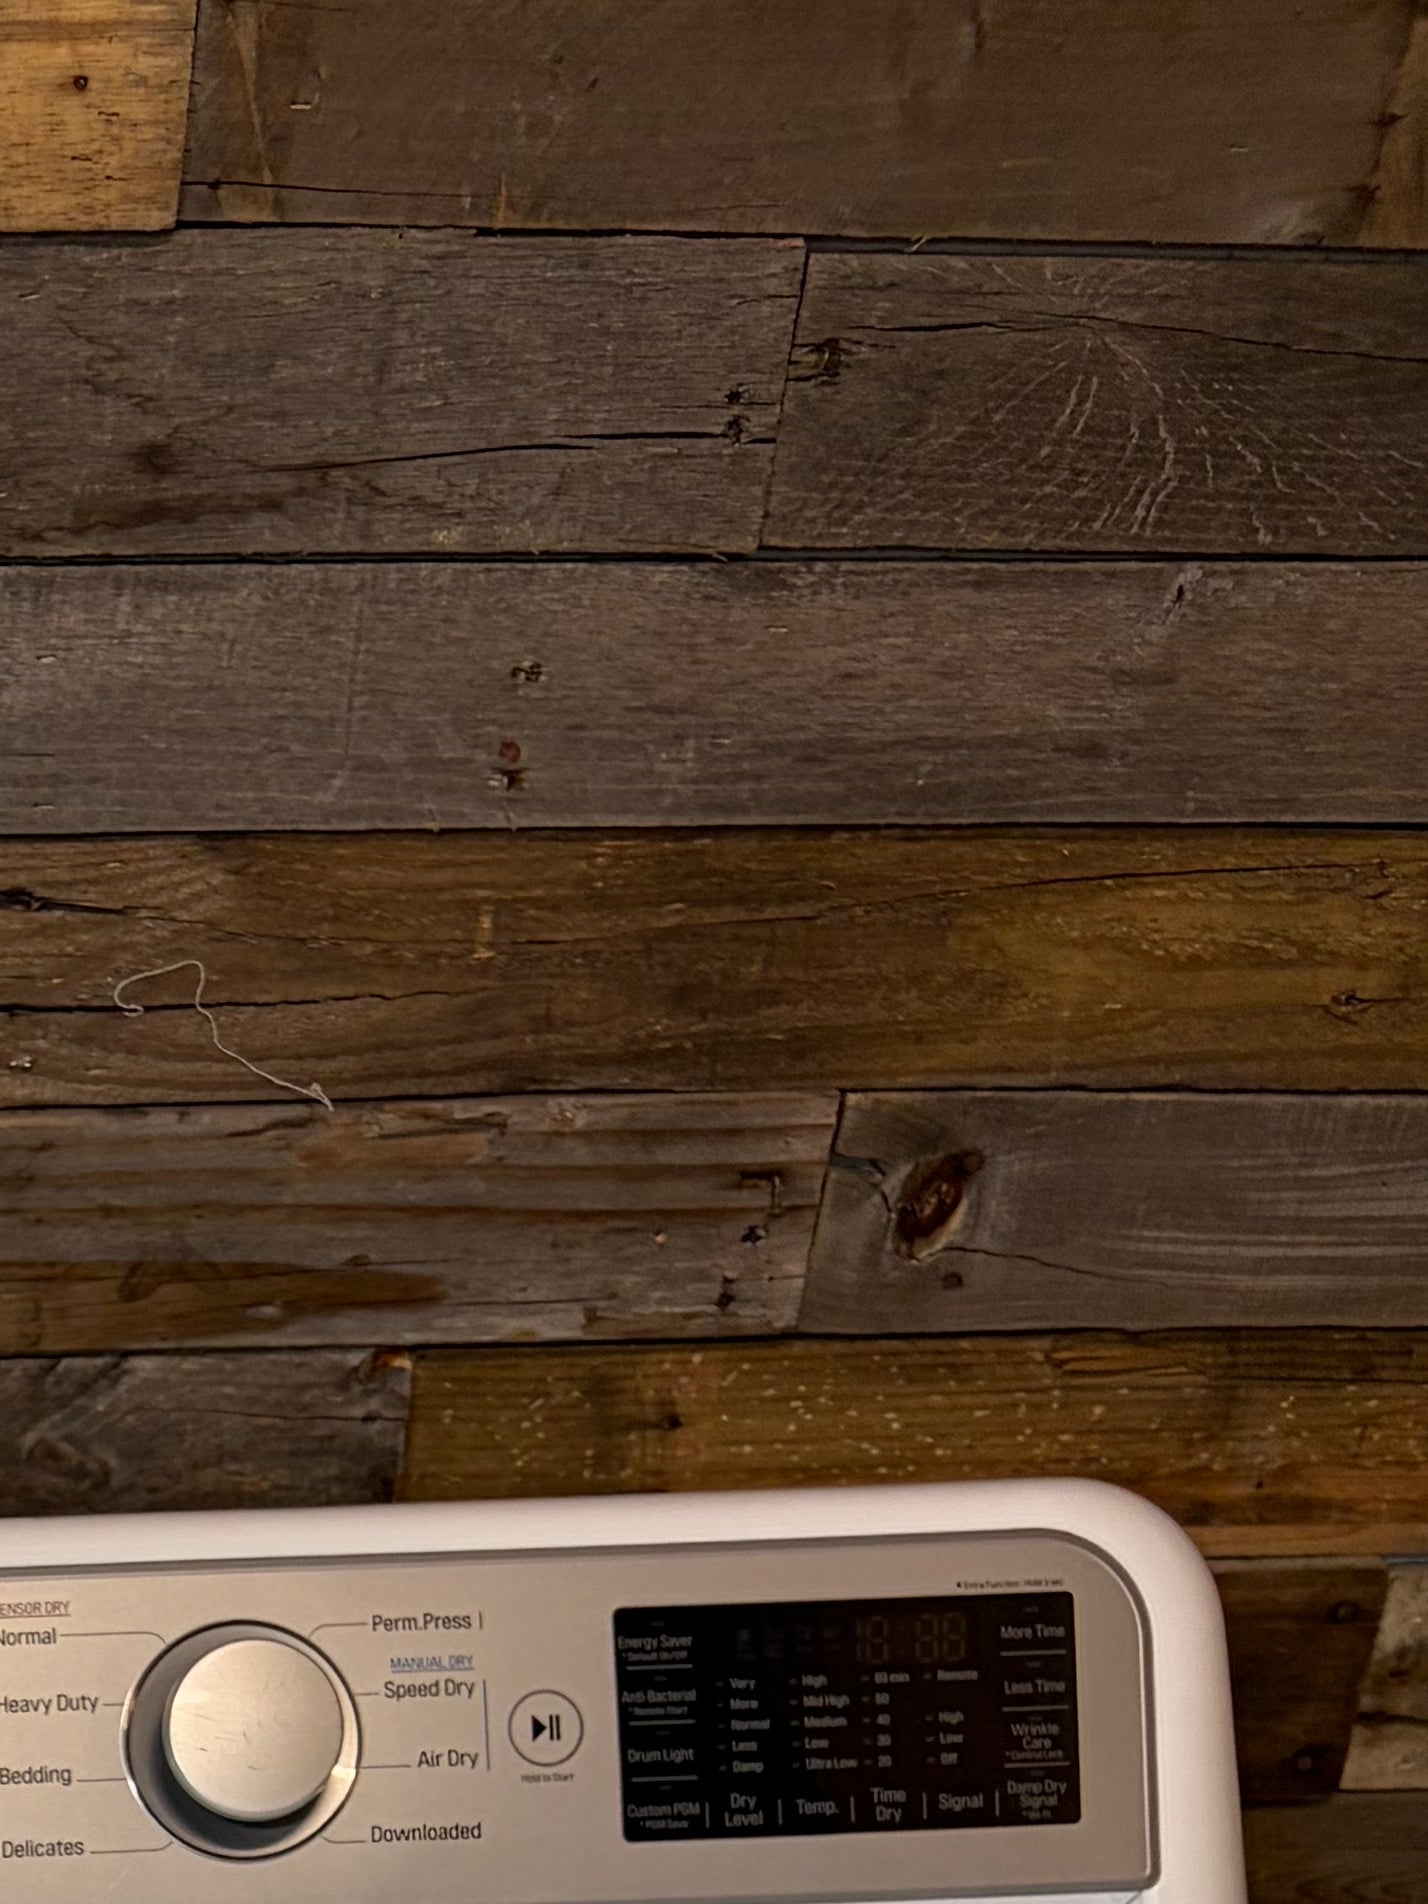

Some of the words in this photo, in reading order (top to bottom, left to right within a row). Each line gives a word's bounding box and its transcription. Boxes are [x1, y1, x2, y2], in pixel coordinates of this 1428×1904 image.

[44, 1601, 70, 1615] DRY
[371, 1612, 472, 1632] Perm.Press
[1000, 1625, 1032, 1640] More
[1035, 1624, 1066, 1638] Time
[617, 1635, 658, 1650] Energy
[660, 1634, 692, 1648] Saver
[390, 1656, 443, 1670] MANUAL
[448, 1655, 474, 1668] DRY
[384, 1680, 440, 1701] Speed
[444, 1678, 475, 1699] Dry
[1004, 1680, 1033, 1694] Less
[1035, 1679, 1066, 1693] Time
[56, 1694, 99, 1713] Duty
[1011, 1723, 1059, 1737] Wrinkle
[1022, 1736, 1052, 1749] Care
[417, 1750, 443, 1768] Air
[448, 1749, 479, 1770] Dry
[627, 1749, 661, 1763] Drum
[663, 1748, 694, 1764] Light
[0, 1765, 71, 1785] Bedding
[730, 1793, 756, 1810] Dry
[870, 1787, 907, 1803] Time
[938, 1792, 984, 1811] Signal
[627, 1804, 672, 1818] Custom
[796, 1799, 840, 1816] Temp.
[876, 1806, 902, 1823] Dry
[725, 1810, 763, 1827] Level
[371, 1822, 482, 1843] Downloaded
[1, 1840, 84, 1859] Delicates
